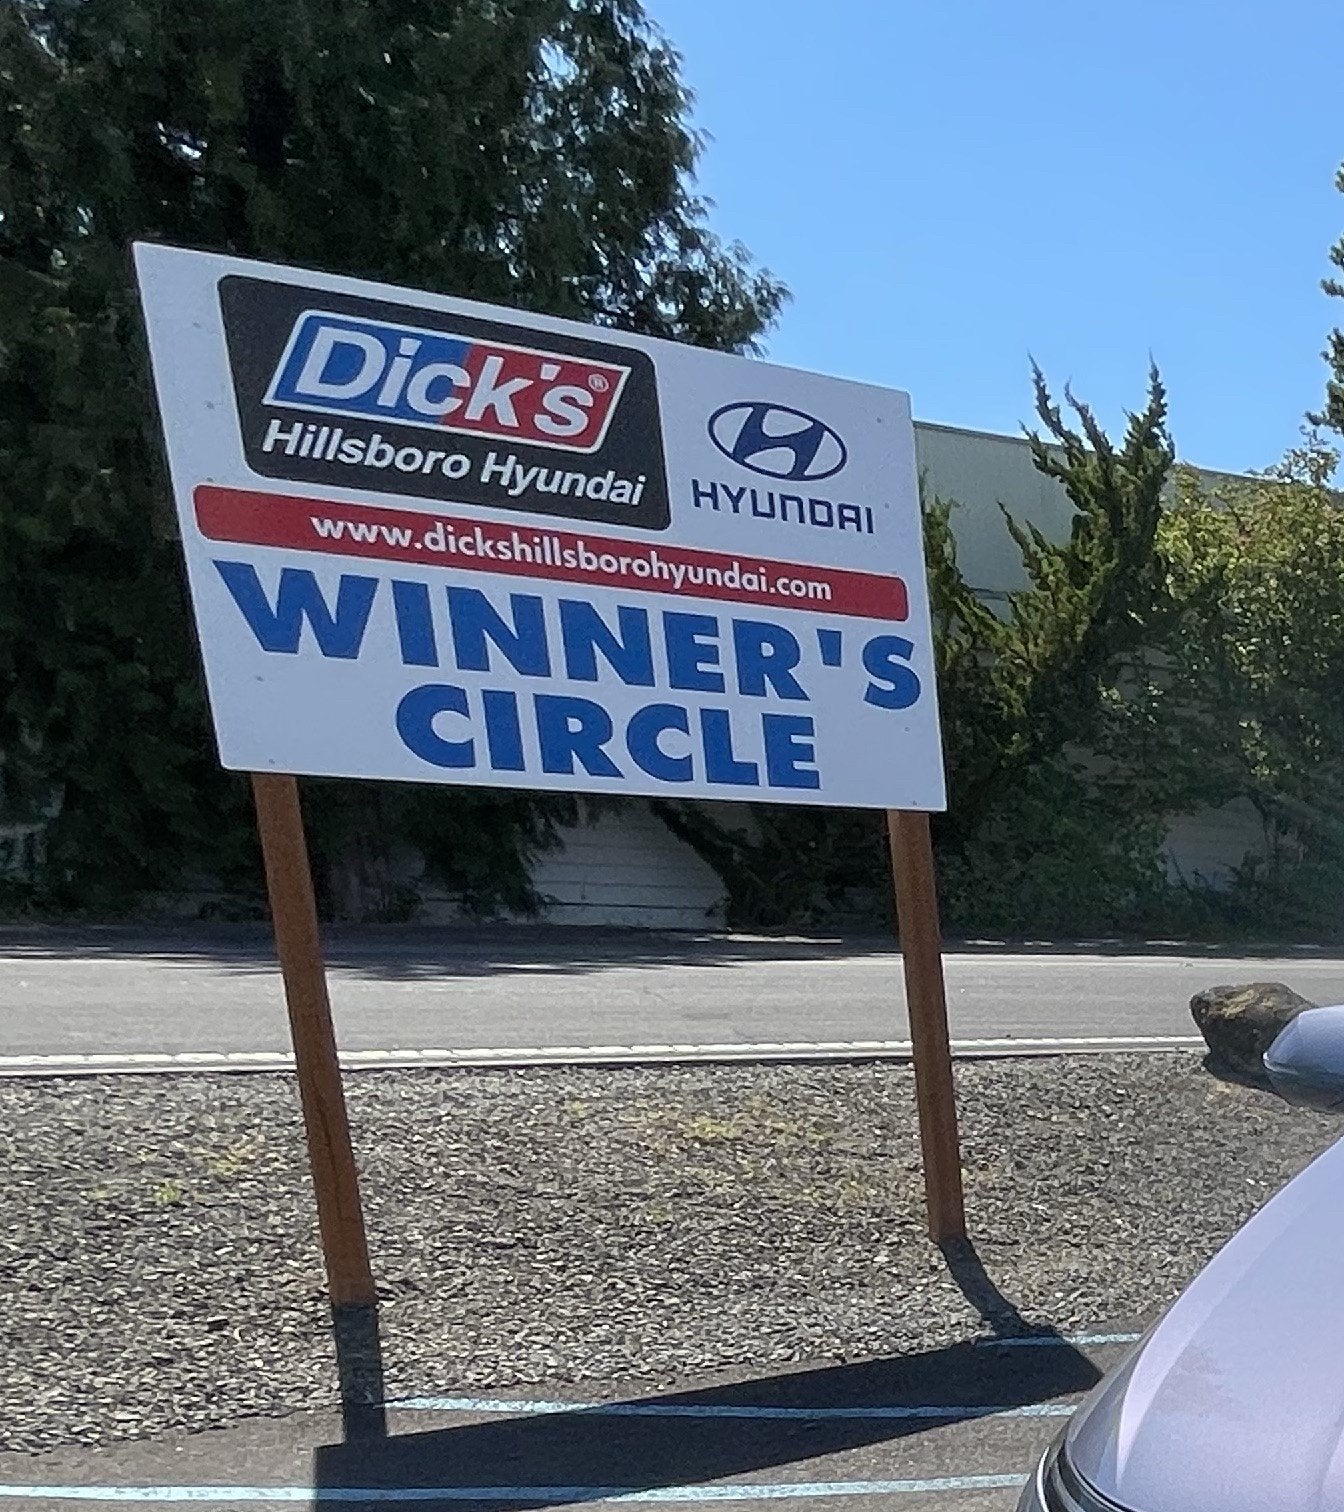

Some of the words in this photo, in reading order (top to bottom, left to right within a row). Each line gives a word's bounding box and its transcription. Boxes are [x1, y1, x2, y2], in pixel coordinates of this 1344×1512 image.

[262, 418, 471, 482] Hillsboro
[480, 452, 647, 508] Hyundai
[692, 478, 875, 535] HYUNDAI
[310, 514, 833, 602] www.dickshillsborohyundai.com
[211, 559, 923, 710] WINNER'S
[394, 682, 823, 791] CIRCLE
